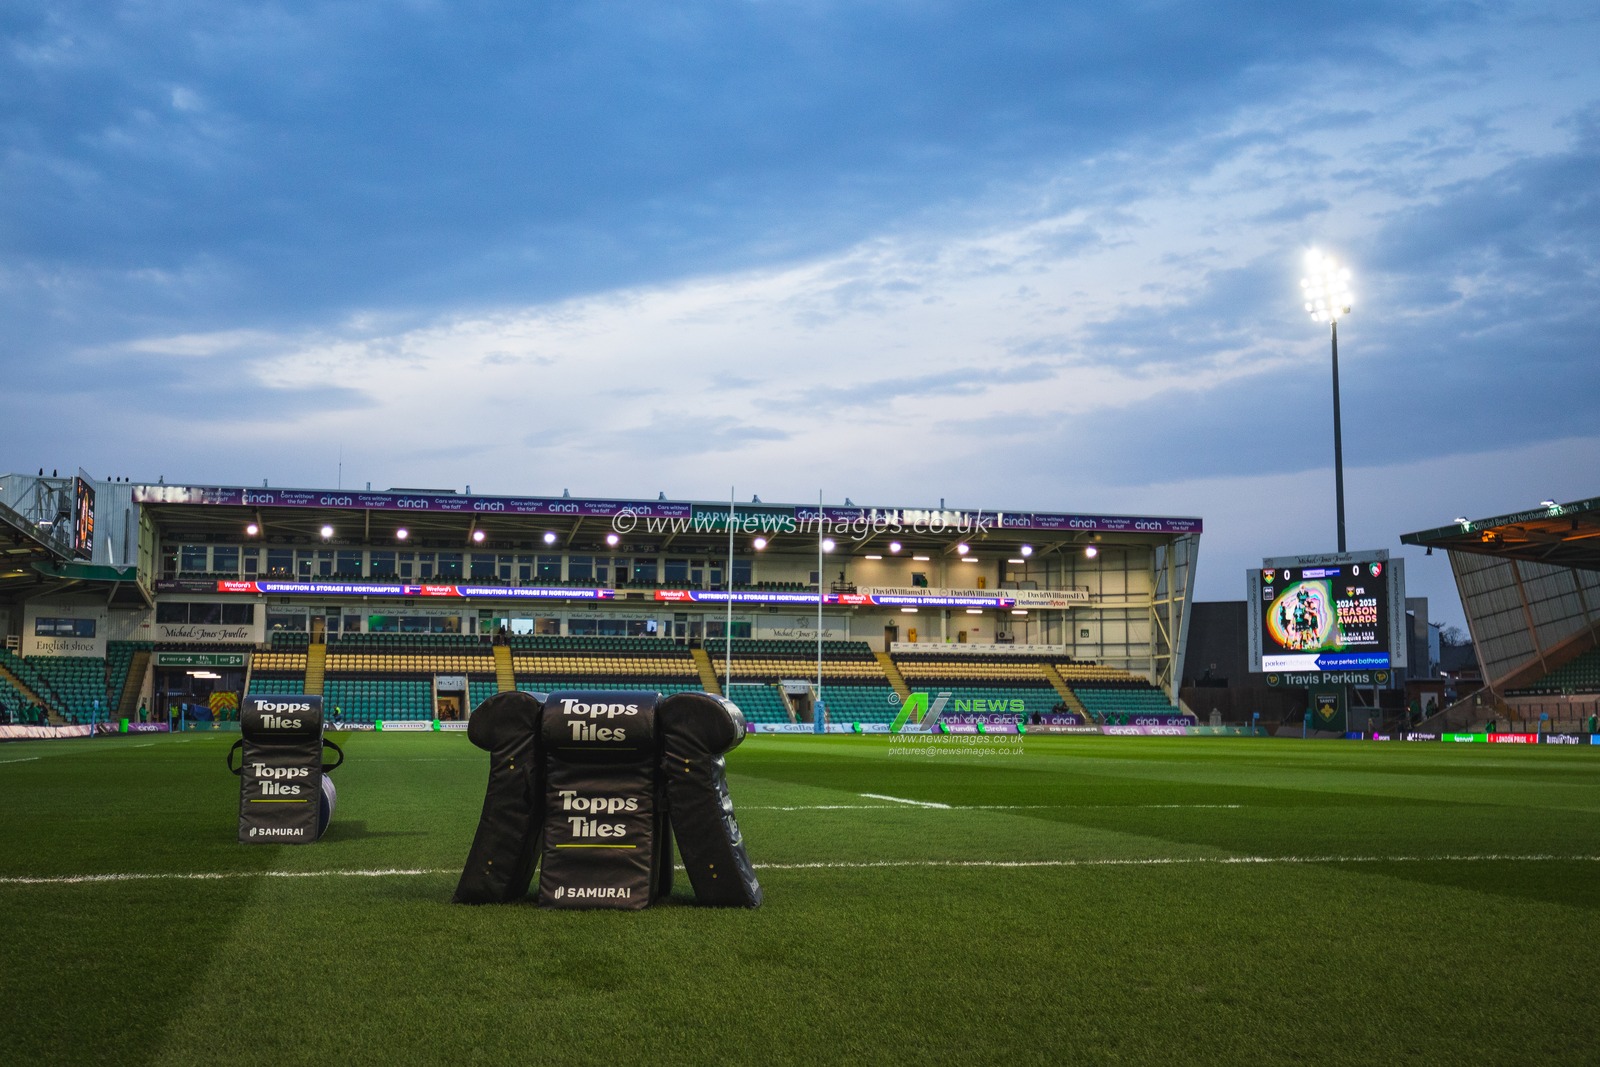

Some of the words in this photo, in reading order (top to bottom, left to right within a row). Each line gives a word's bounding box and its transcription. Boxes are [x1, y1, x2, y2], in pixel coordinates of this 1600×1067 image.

[242, 491, 274, 503] cinch
[320, 494, 352, 506] cinch
[397, 497, 428, 509] cinch
[474, 500, 504, 511] cinch
[548, 501, 578, 513] cinch
[697, 512, 747, 523] BARWELL
[753, 514, 789, 524] STAND
[1003, 515, 1030, 527] cinch
[1069, 517, 1096, 528] cinch
[1474, 520, 1495, 530] Official
[1495, 517, 1508, 526] Beer
[1517, 507, 1558, 521] Northampton
[1559, 505, 1578, 515] Saints
[1135, 519, 1162, 530] cinch
[1284, 570, 1290, 580] 0
[1353, 565, 1360, 576] 0
[950, 590, 1008, 598] DavidWilliamsIFA
[1027, 591, 1085, 599] DavidWilliamsIFA
[1336, 600, 1353, 608] 2024
[1359, 599, 1376, 607] 2025
[1337, 607, 1377, 616] SEASON
[1338, 615, 1377, 624] AWARDS
[161, 625, 197, 638] Michael
[196, 629, 217, 640] Jones
[218, 627, 248, 640] Jeweller
[770, 628, 794, 638] Michael
[796, 630, 810, 640] Jones
[36, 641, 68, 654] English
[71, 642, 94, 651] shoes
[1284, 673, 1319, 684] Travis
[1323, 672, 1369, 684] Perkins
[254, 700, 310, 713] Topps
[560, 699, 638, 718] Topps
[260, 715, 301, 728] Tiles
[1052, 714, 1075, 724] cinch
[1136, 716, 1159, 726] cinch
[1167, 716, 1190, 726] cinch
[567, 720, 626, 741] Tiles
[1110, 725, 1140, 735] cinch
[1151, 726, 1181, 735] cinch
[252, 763, 309, 779] Topps
[259, 781, 300, 795] Tiles
[559, 790, 638, 814] Topps
[568, 817, 626, 837] Tiles
[567, 888, 630, 898] SAMURAI
